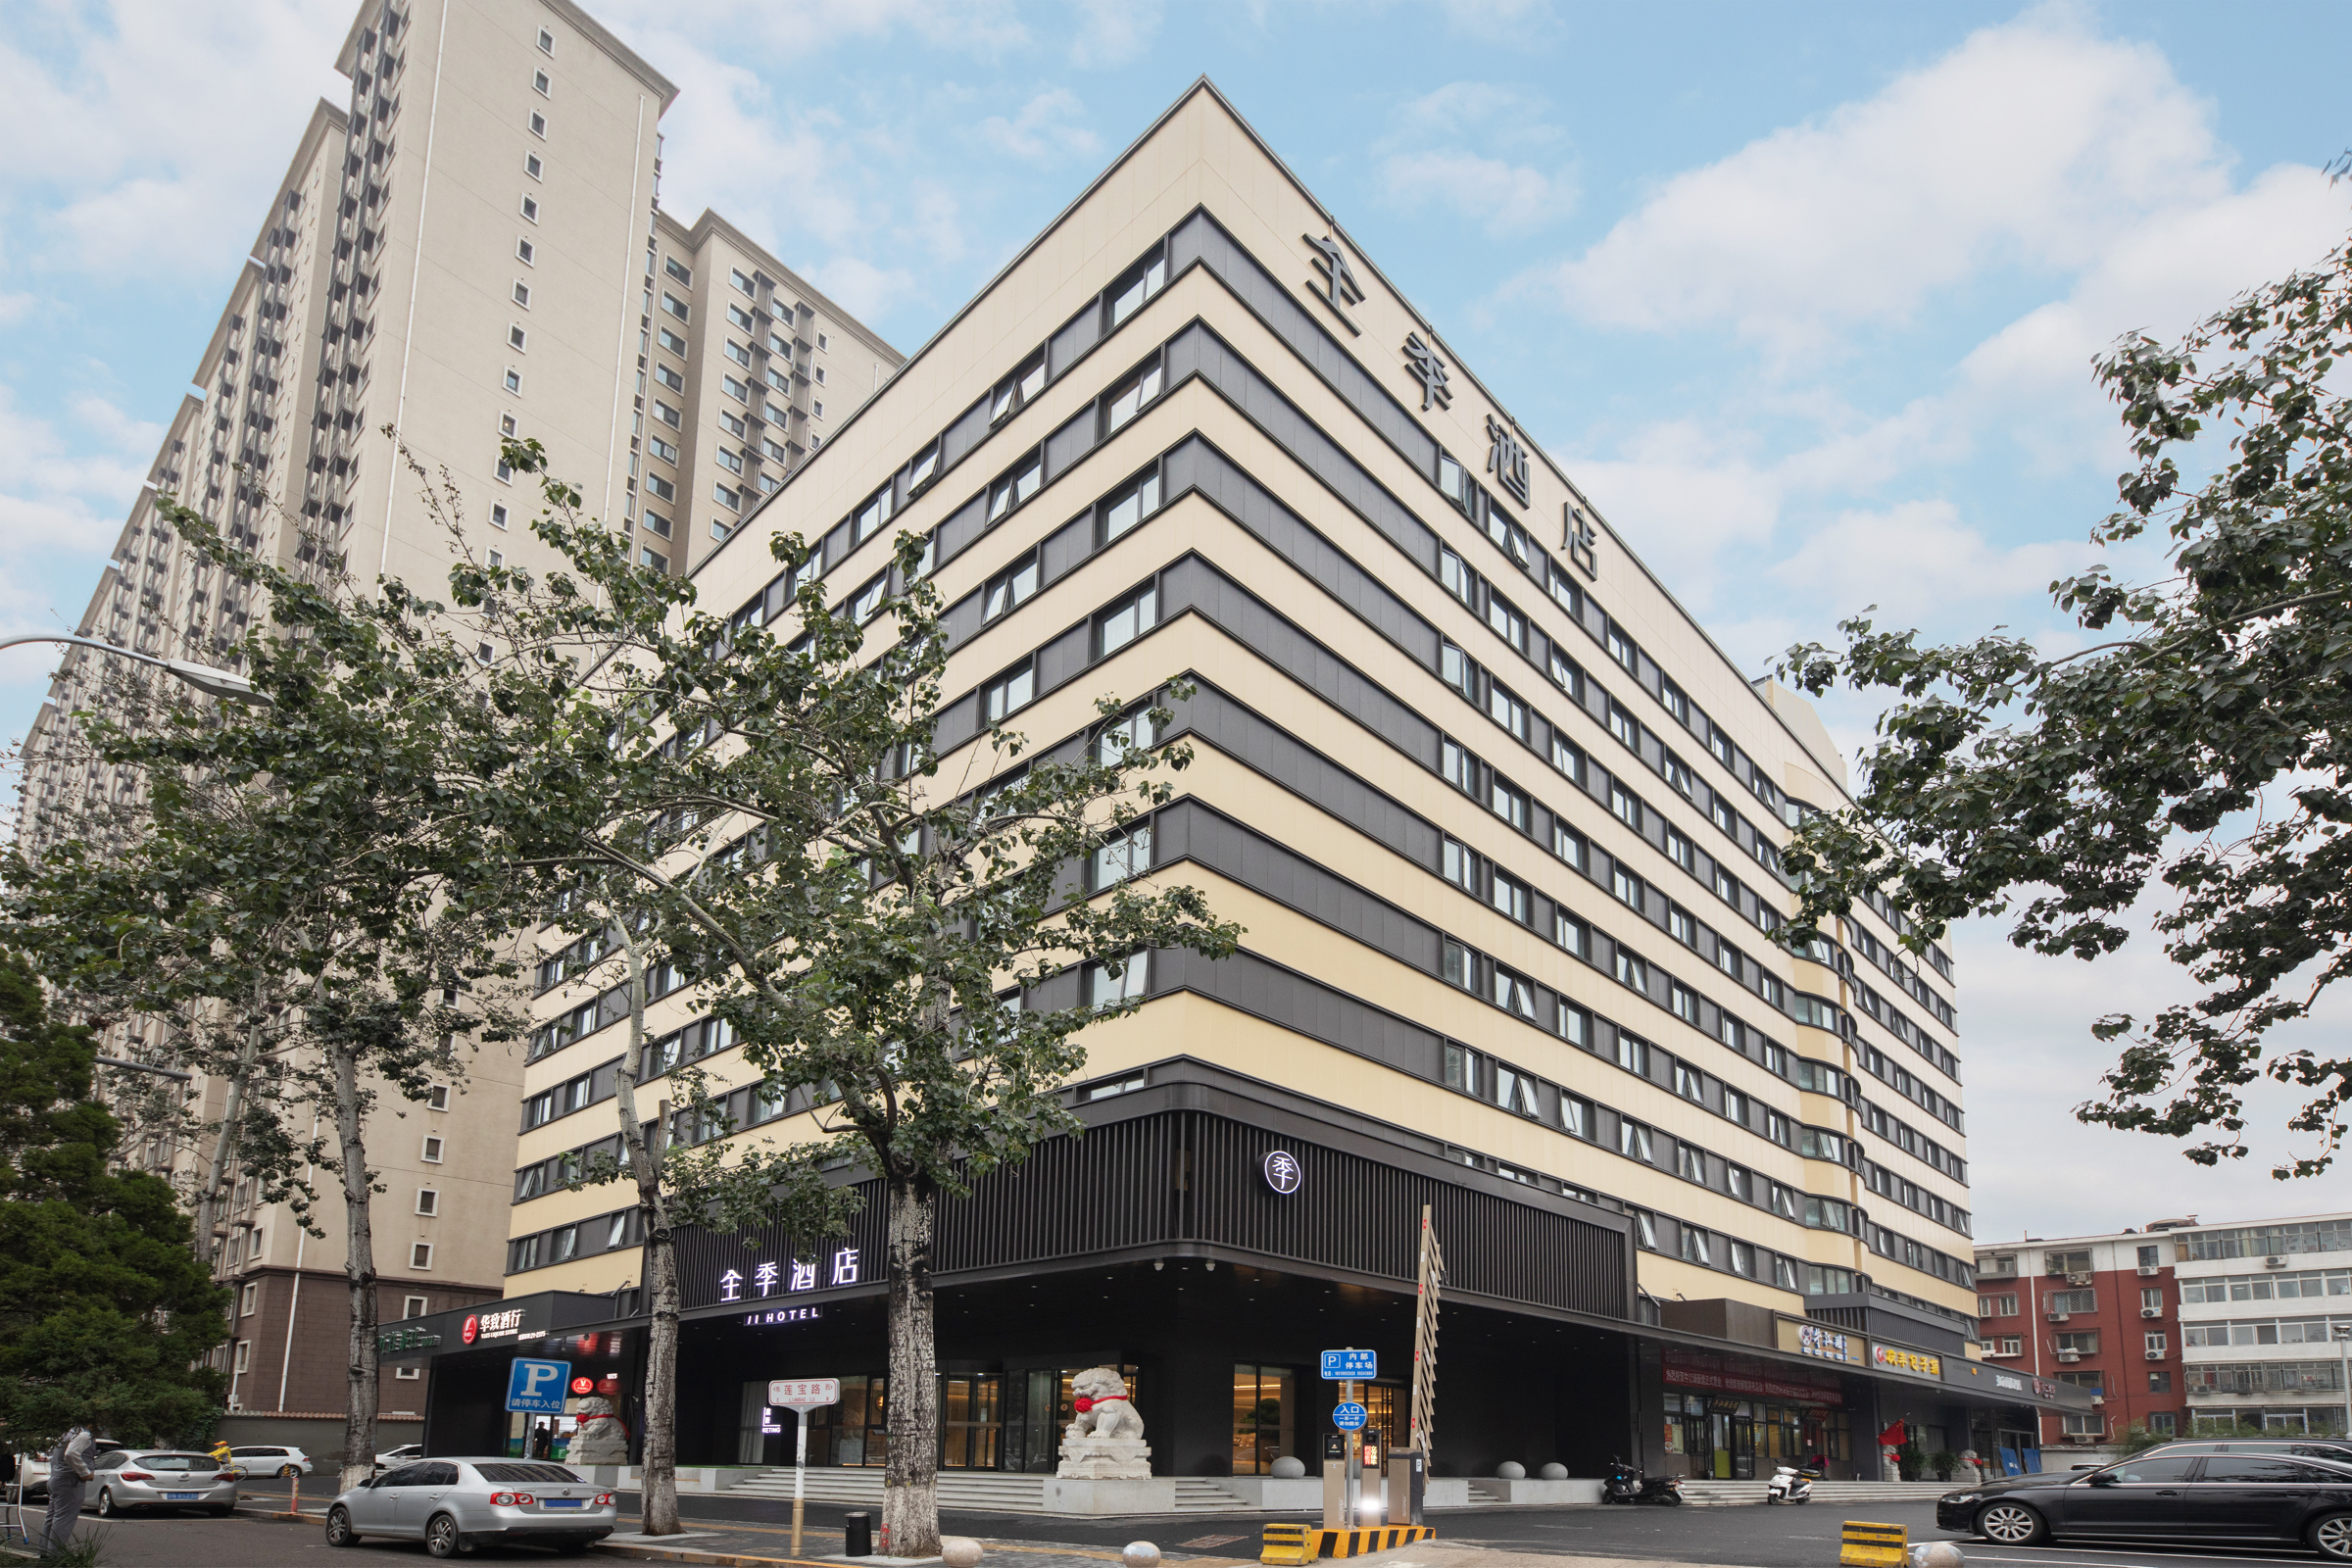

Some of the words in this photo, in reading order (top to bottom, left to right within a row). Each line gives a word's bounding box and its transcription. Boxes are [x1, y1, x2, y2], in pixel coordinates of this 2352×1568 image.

[1302, 232, 1597, 582] 全季酒店
[1271, 1156, 1294, 1190] 季
[719, 1248, 859, 1302] 全季酒店
[479, 1308, 522, 1333] 华致酒行
[765, 1307, 819, 1323] HOTEL
[1328, 1355, 1337, 1367] P
[1348, 1352, 1369, 1361] 内部
[1346, 1361, 1373, 1370] 停车场
[519, 1363, 559, 1396] P
[784, 1383, 821, 1396] 莲宝路
[511, 1398, 562, 1409] 请停车入位
[1340, 1404, 1360, 1414] 入口
